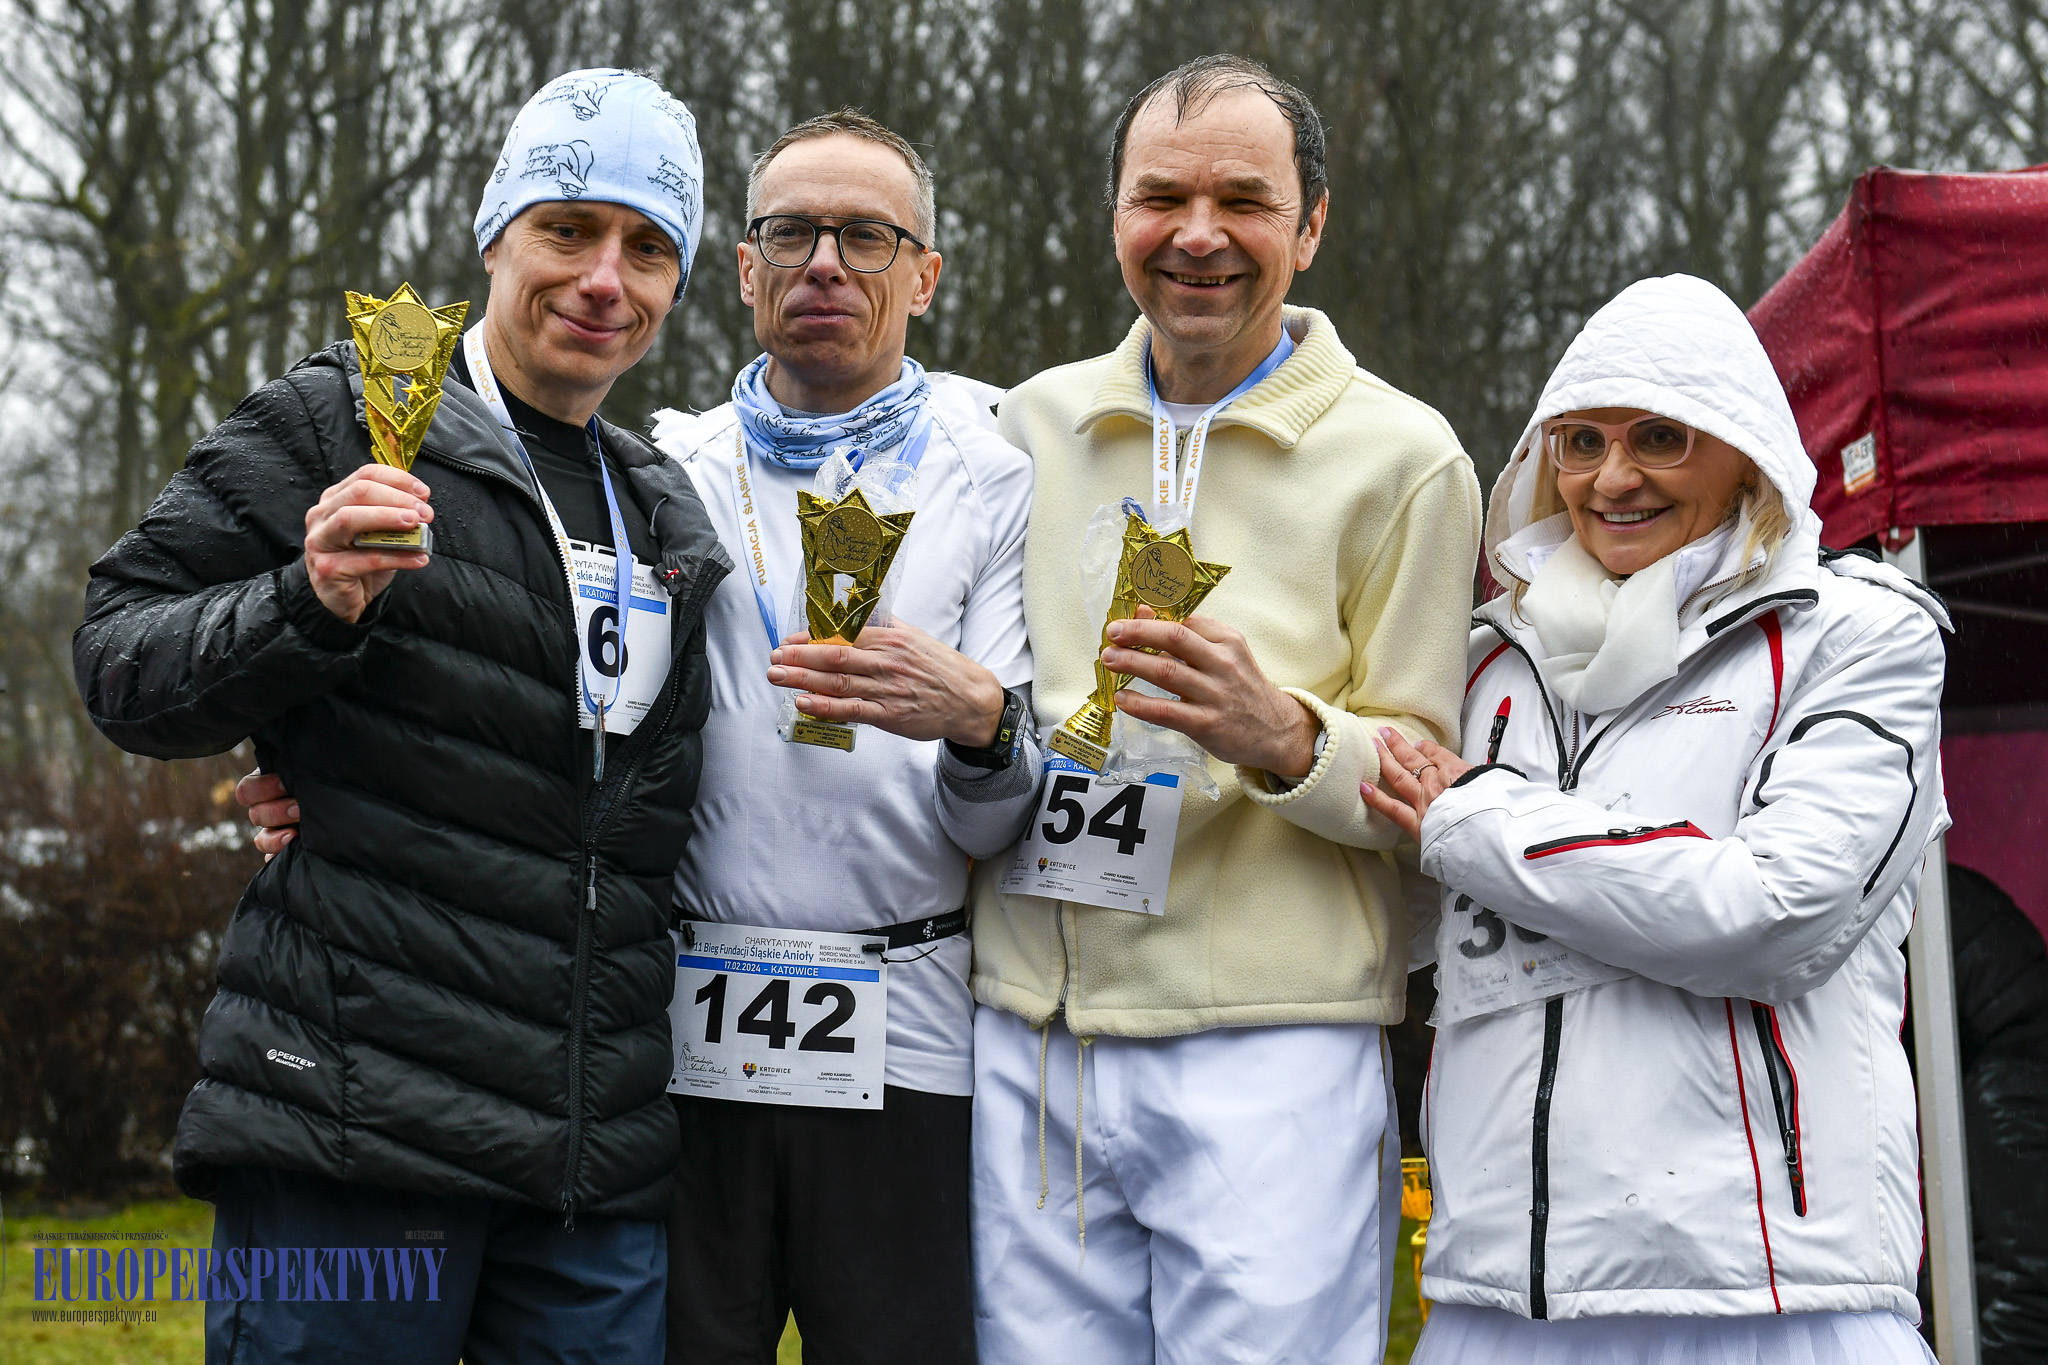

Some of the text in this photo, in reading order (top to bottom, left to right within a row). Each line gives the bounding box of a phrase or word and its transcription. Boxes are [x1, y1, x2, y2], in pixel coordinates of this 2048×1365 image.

[474, 360, 497, 403] ANIOŁY
[1159, 416, 1169, 472] ANIOŁY
[1189, 416, 1207, 469] ANIOŁY
[737, 462, 753, 515] ŚLĄSKIE
[574, 559, 616, 574] RYTATYWNY
[747, 519, 767, 586] FUNDACJA
[576, 570, 618, 588] skie Anioły
[585, 587, 617, 602] KATOWIC
[1025, 774, 1147, 856] 54
[744, 936, 813, 949] CHARYTATYWNY
[1454, 893, 1549, 959] 3
[703, 942, 719, 956] Bieg
[720, 943, 750, 958] Fundacji
[750, 945, 781, 960] Śląskie
[782, 949, 815, 963] Anioły
[724, 960, 761, 972] 17.02.2024
[770, 965, 819, 976] KATOWICE
[694, 973, 857, 1054] 142
[759, 1066, 791, 1074] KATOWICE
